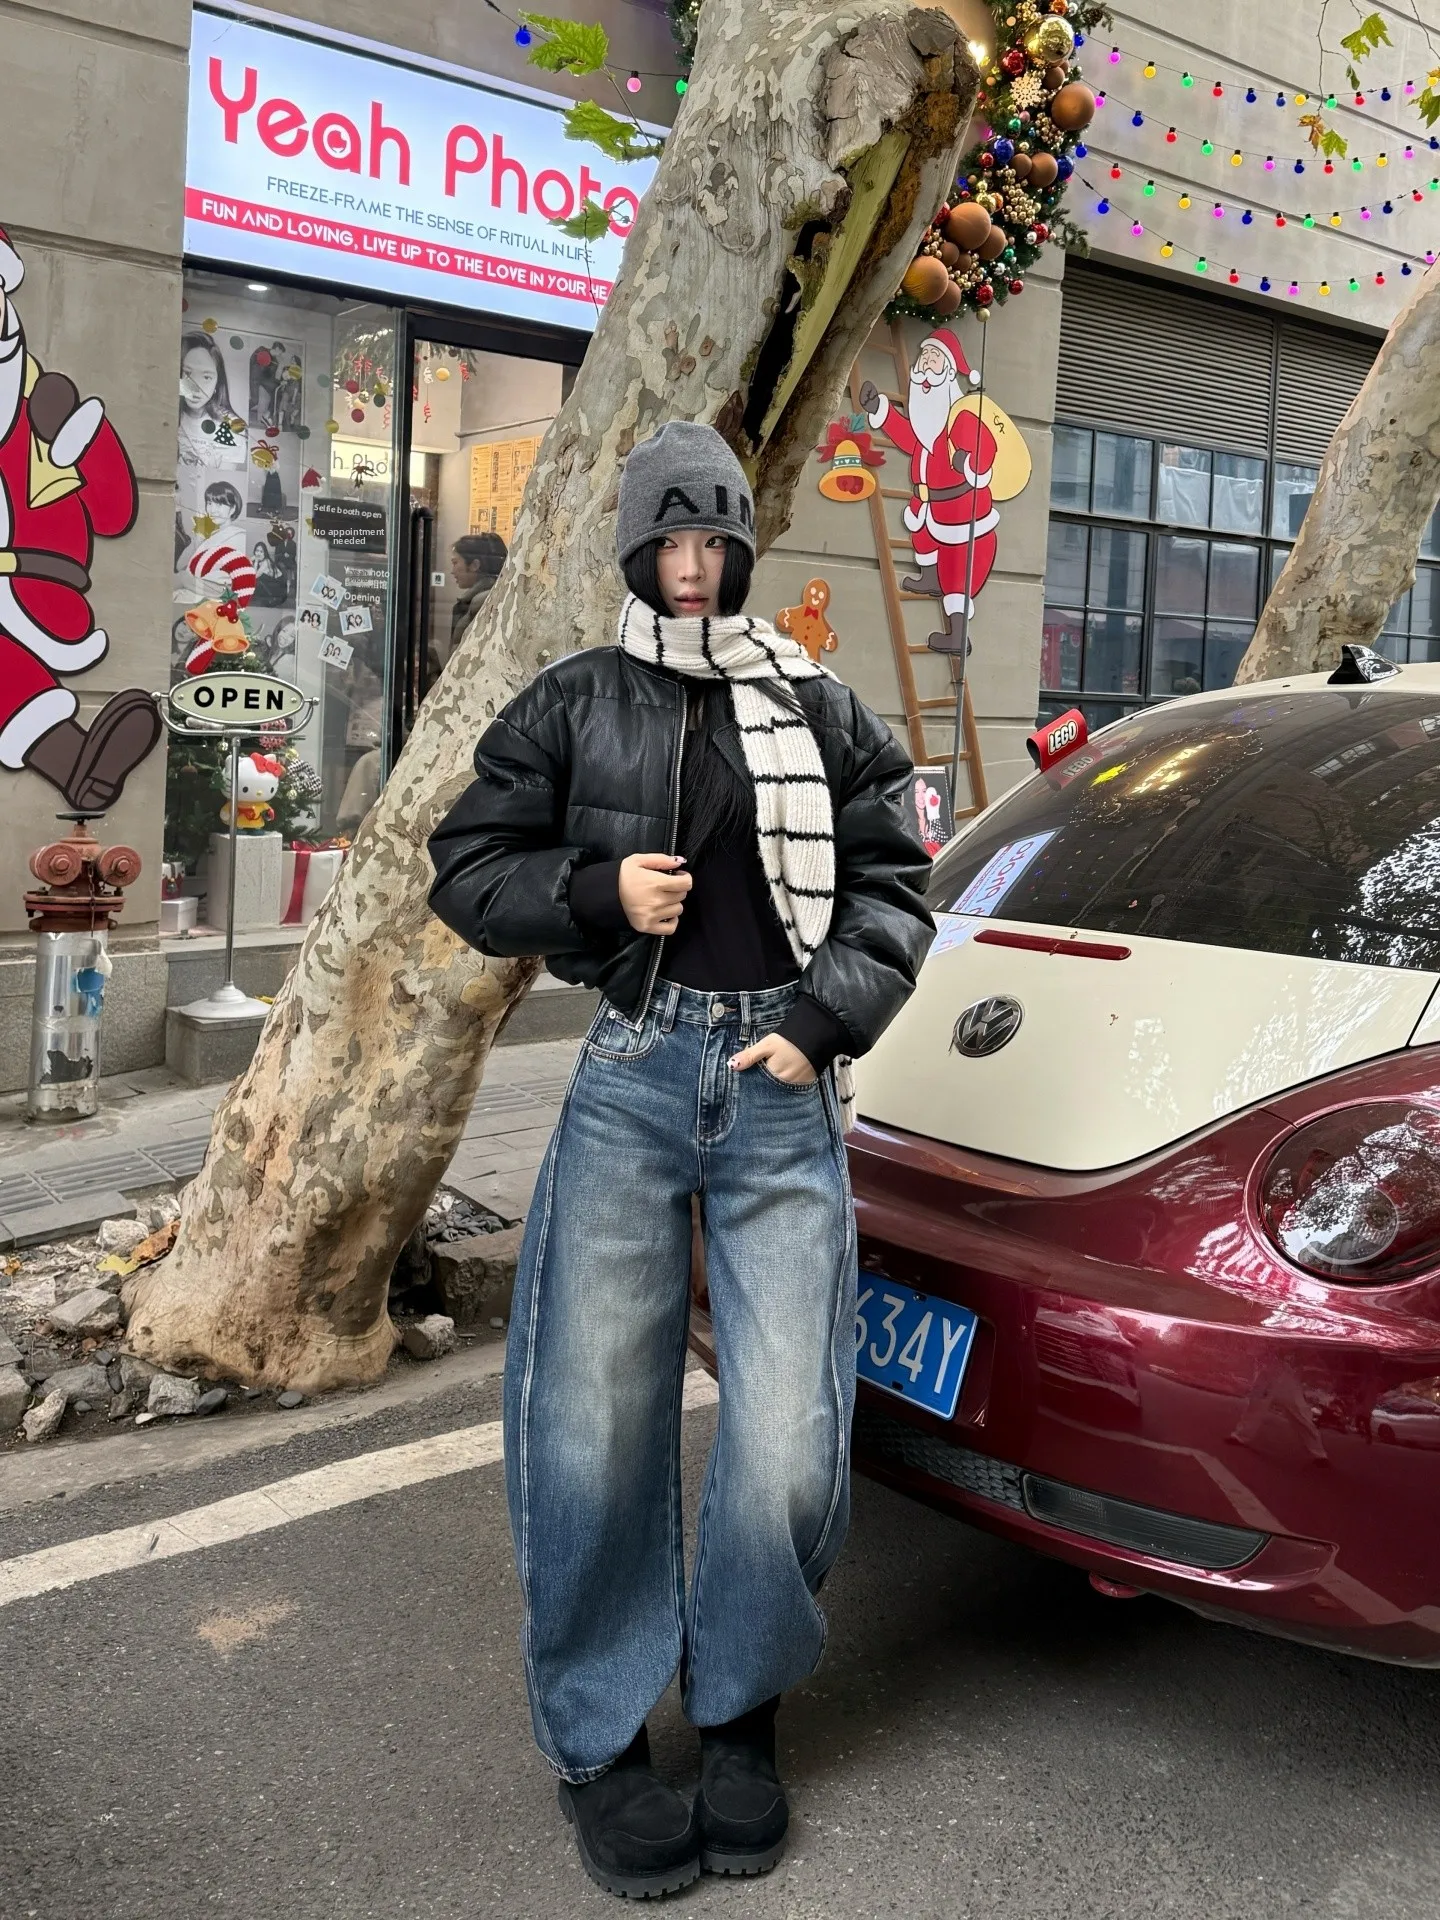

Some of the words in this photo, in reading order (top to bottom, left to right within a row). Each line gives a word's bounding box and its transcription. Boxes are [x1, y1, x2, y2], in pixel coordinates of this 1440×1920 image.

[209, 56, 410, 186] Yeah
[445, 124, 640, 238] Photo
[267, 176, 391, 218] FREEZE-FRAME
[395, 206, 423, 225] THE
[427, 214, 474, 236] SENSE
[477, 226, 497, 241] OF
[500, 230, 549, 254] RITUAL
[552, 242, 565, 256] IN
[202, 198, 237, 221] FUN
[241, 209, 283, 231] AND
[287, 218, 358, 250] LOVING,
[363, 235, 397, 256] LIVE
[401, 243, 421, 260] UP
[426, 248, 450, 266] TO
[454, 254, 483, 274] THE
[487, 262, 526, 283] LOVE
[530, 271, 544, 287] IN
[548, 275, 586, 296] YOUR
[313, 504, 336, 513] Selfie
[337, 506, 360, 516] booth
[361, 510, 382, 519] open
[313, 528, 326, 536] No
[328, 528, 385, 537] appointment
[333, 537, 366, 545] needed
[344, 592, 381, 604] Opening
[194, 686, 283, 710] OPEN
[1048, 720, 1077, 754] LEGO
